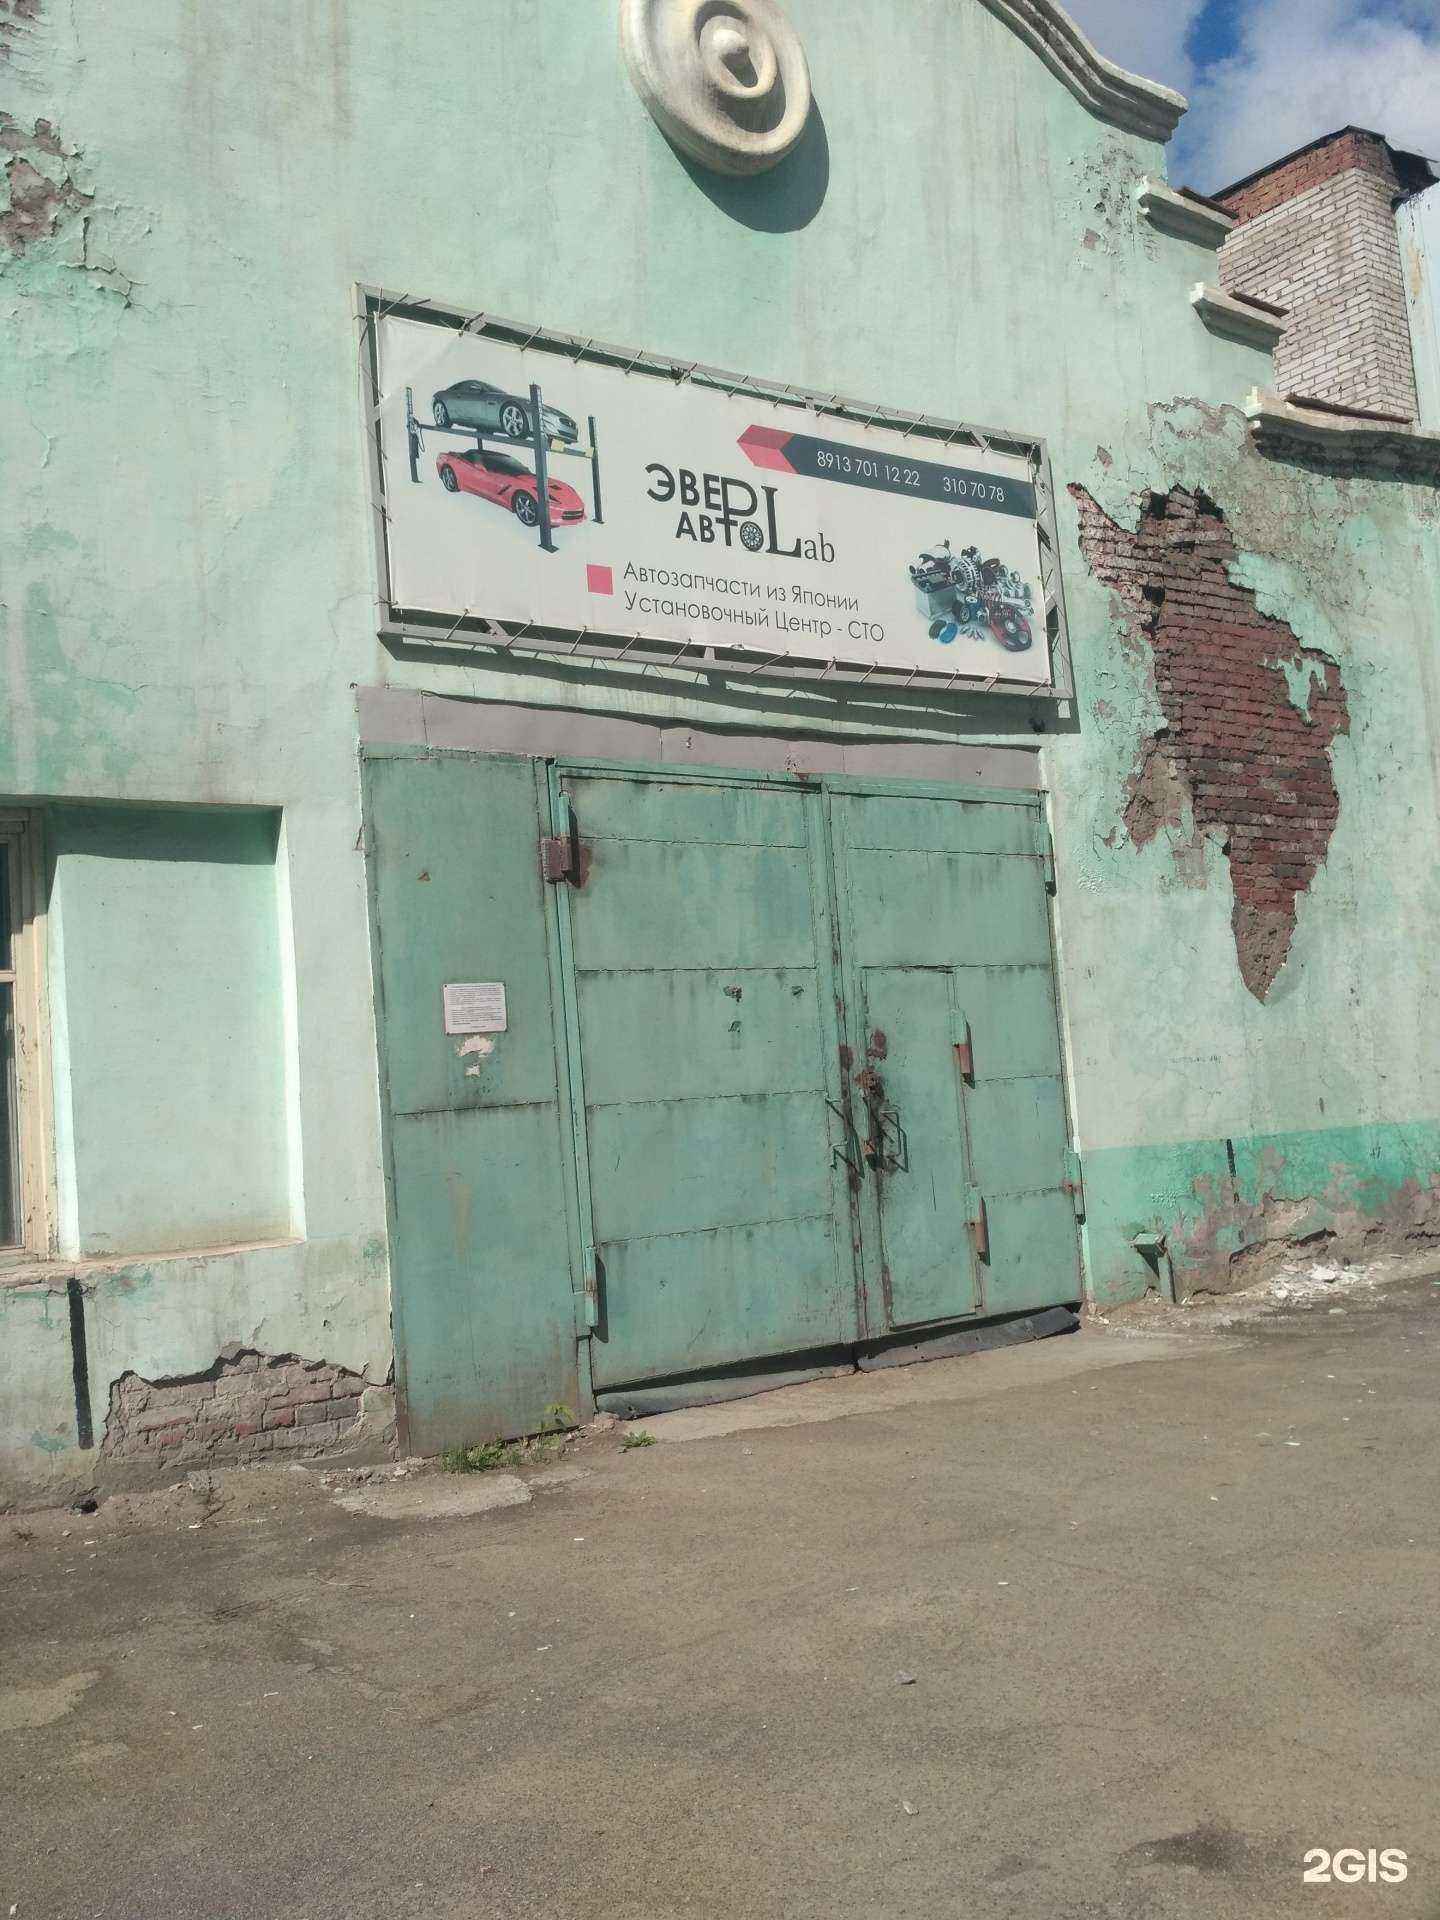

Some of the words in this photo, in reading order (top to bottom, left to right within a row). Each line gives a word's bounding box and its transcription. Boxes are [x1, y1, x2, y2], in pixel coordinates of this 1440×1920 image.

[817, 450, 851, 473] 8913
[855, 459, 878, 479] 701
[885, 465, 901, 483] 12
[903, 469, 921, 487] 22
[943, 476, 967, 496] 310
[970, 481, 986, 499] 70
[988, 485, 1006, 503] 78
[761, 485, 835, 563] Lab
[623, 561, 760, 598] Автозапчасти
[767, 585, 786, 602] из
[791, 585, 859, 613] Японии
[624, 590, 769, 628] Установочный
[775, 611, 832, 638] Центр
[847, 620, 885, 642] СТО
